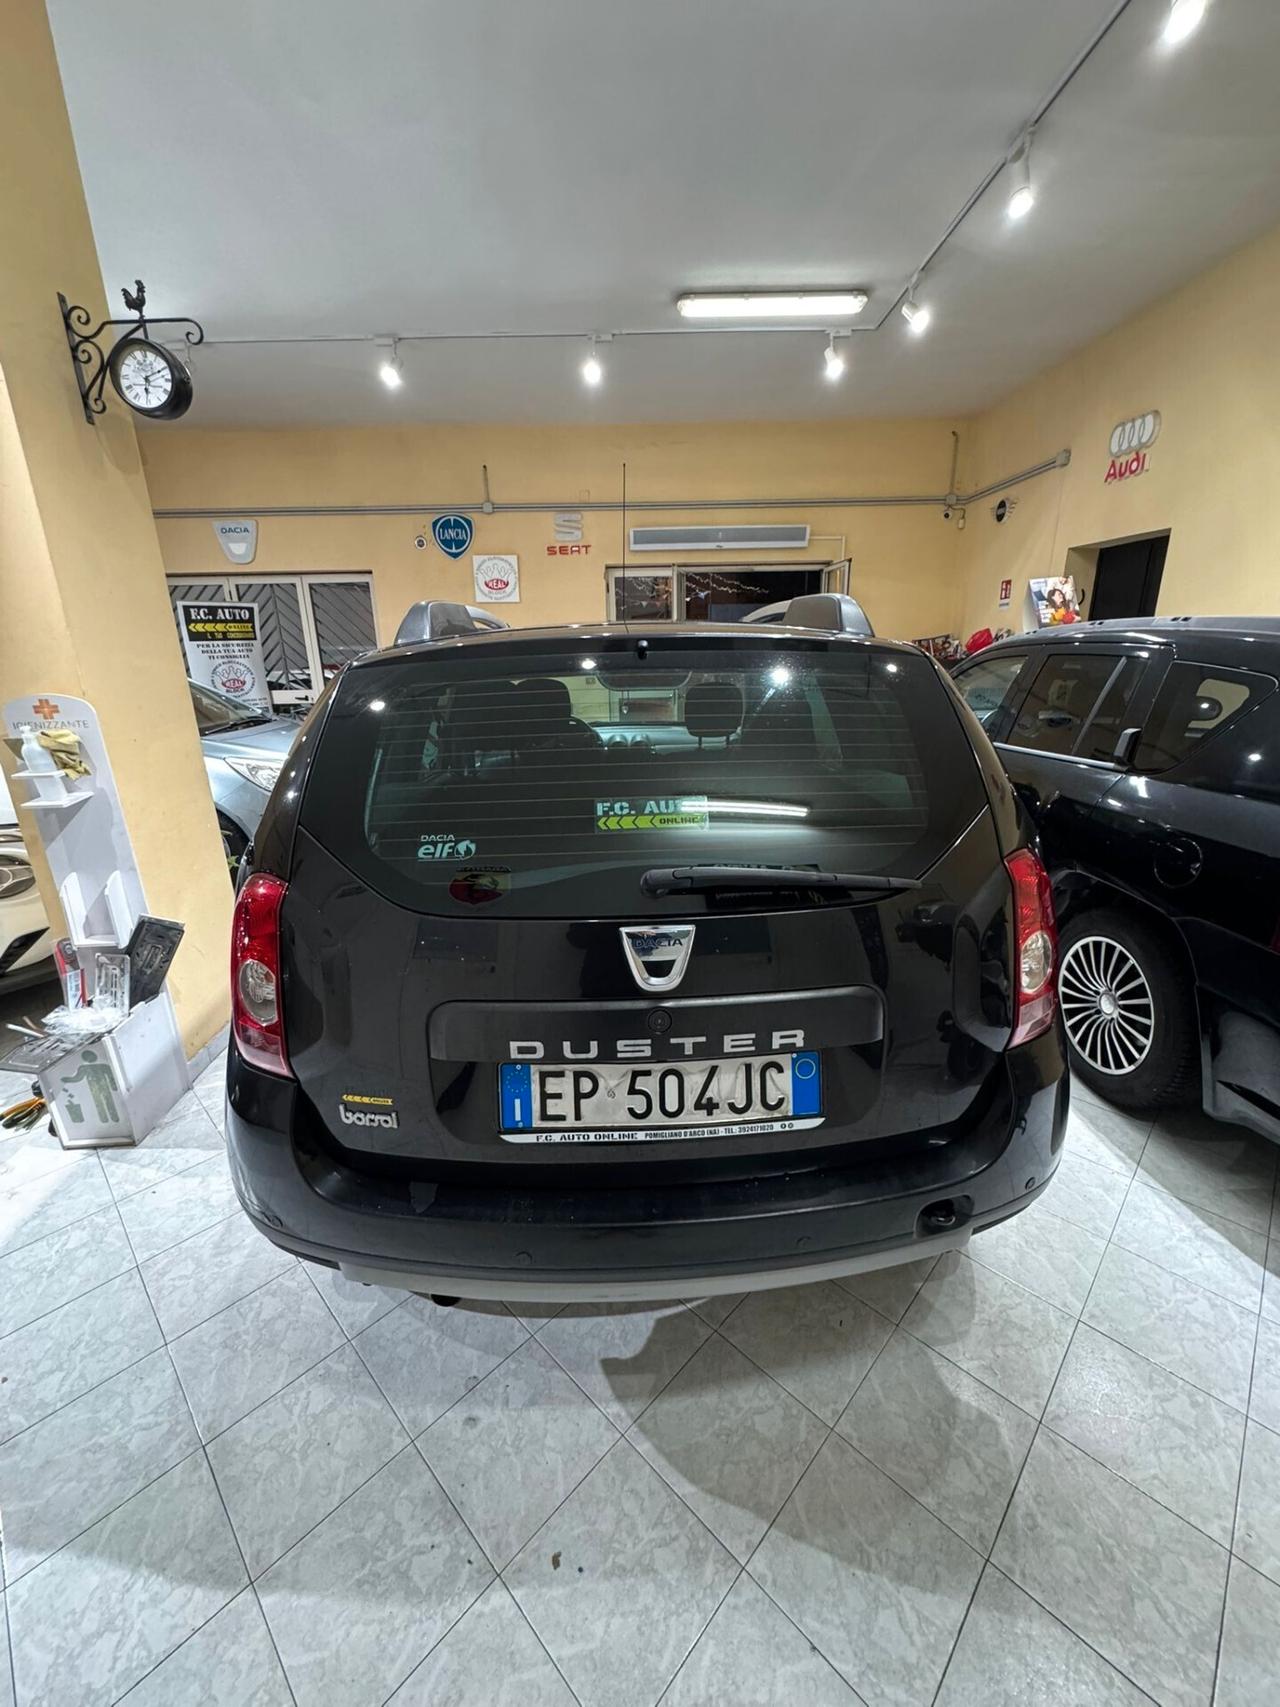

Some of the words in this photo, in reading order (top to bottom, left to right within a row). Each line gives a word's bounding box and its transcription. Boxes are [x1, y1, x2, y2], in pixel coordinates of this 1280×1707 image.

[1104, 451, 1147, 483] Audi
[220, 526, 250, 534] DACIA
[439, 528, 467, 541] LANCIA
[546, 545, 592, 556] SEAT
[189, 607, 213, 620] F.C.
[216, 608, 250, 620] AUTO
[596, 801, 637, 816] F.C.
[420, 834, 456, 842] DACIA
[417, 842, 456, 859] elf
[635, 937, 683, 948] DACIA
[509, 1029, 805, 1060] DUSTER
[540, 1069, 600, 1121] EP
[627, 1060, 786, 1120] 504JC
[559, 1133, 591, 1142] AUTO
[593, 1132, 638, 1141] ONLINE
[644, 1130, 682, 1139] POMIGLIANO
